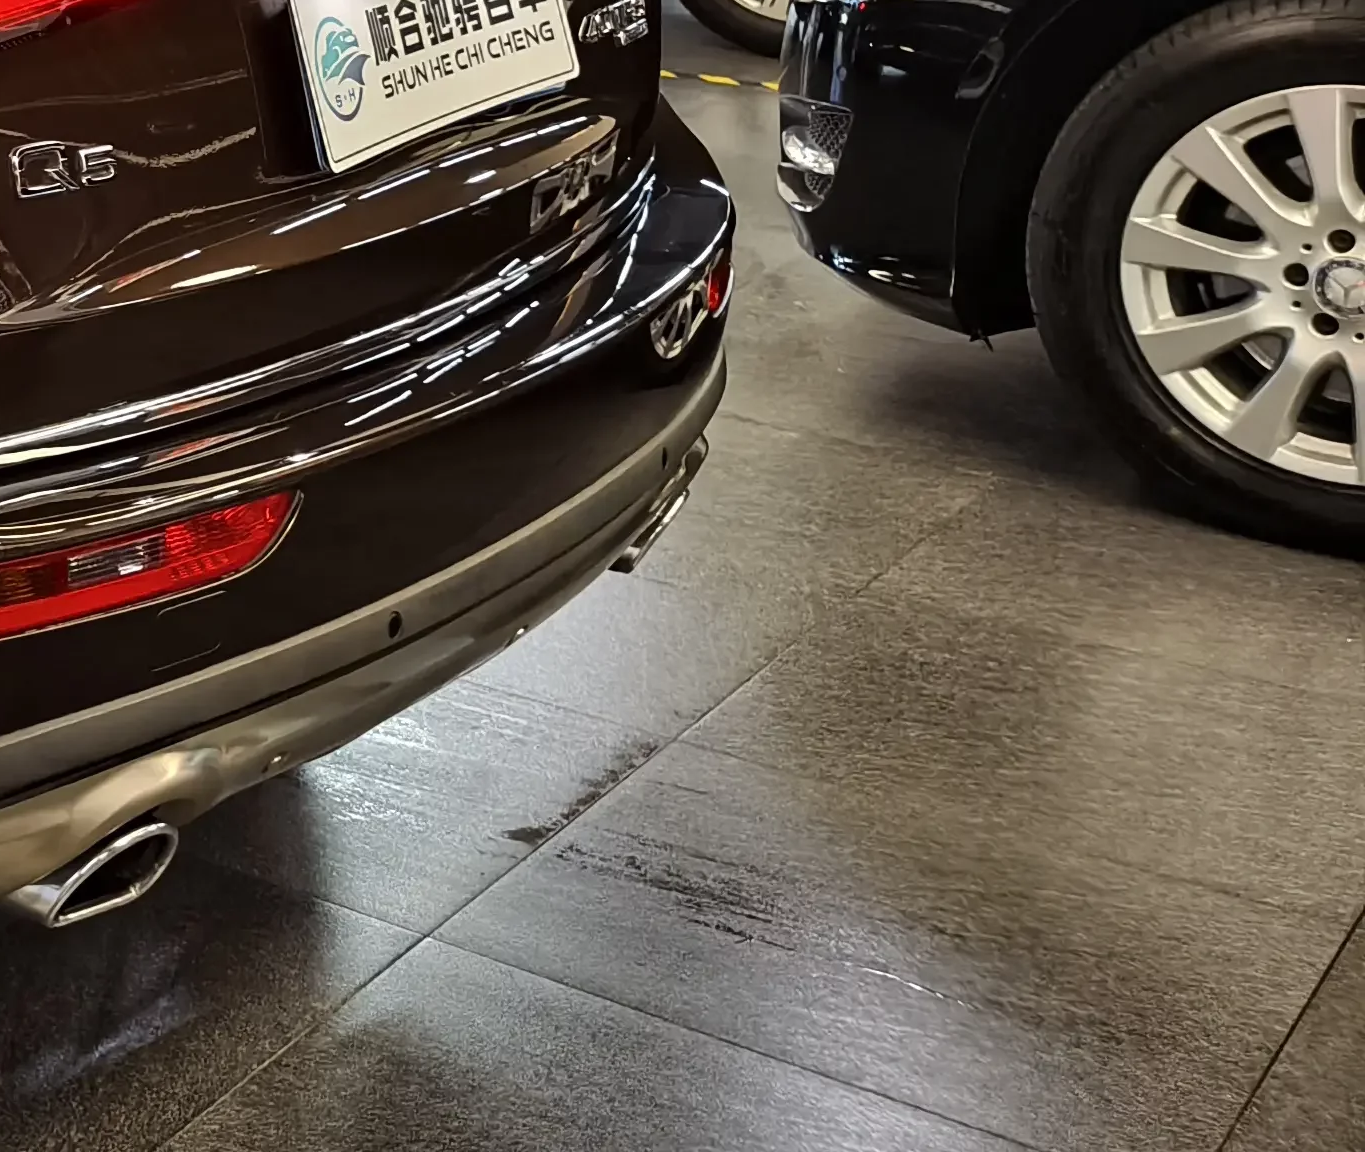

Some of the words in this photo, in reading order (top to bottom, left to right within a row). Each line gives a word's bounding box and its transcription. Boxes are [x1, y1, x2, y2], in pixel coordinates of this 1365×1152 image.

[381, 63, 429, 98] SHUN
[430, 54, 454, 81] HE
[455, 42, 486, 70] CHI
[486, 20, 555, 59] CHENG
[9, 140, 118, 199] Q5
